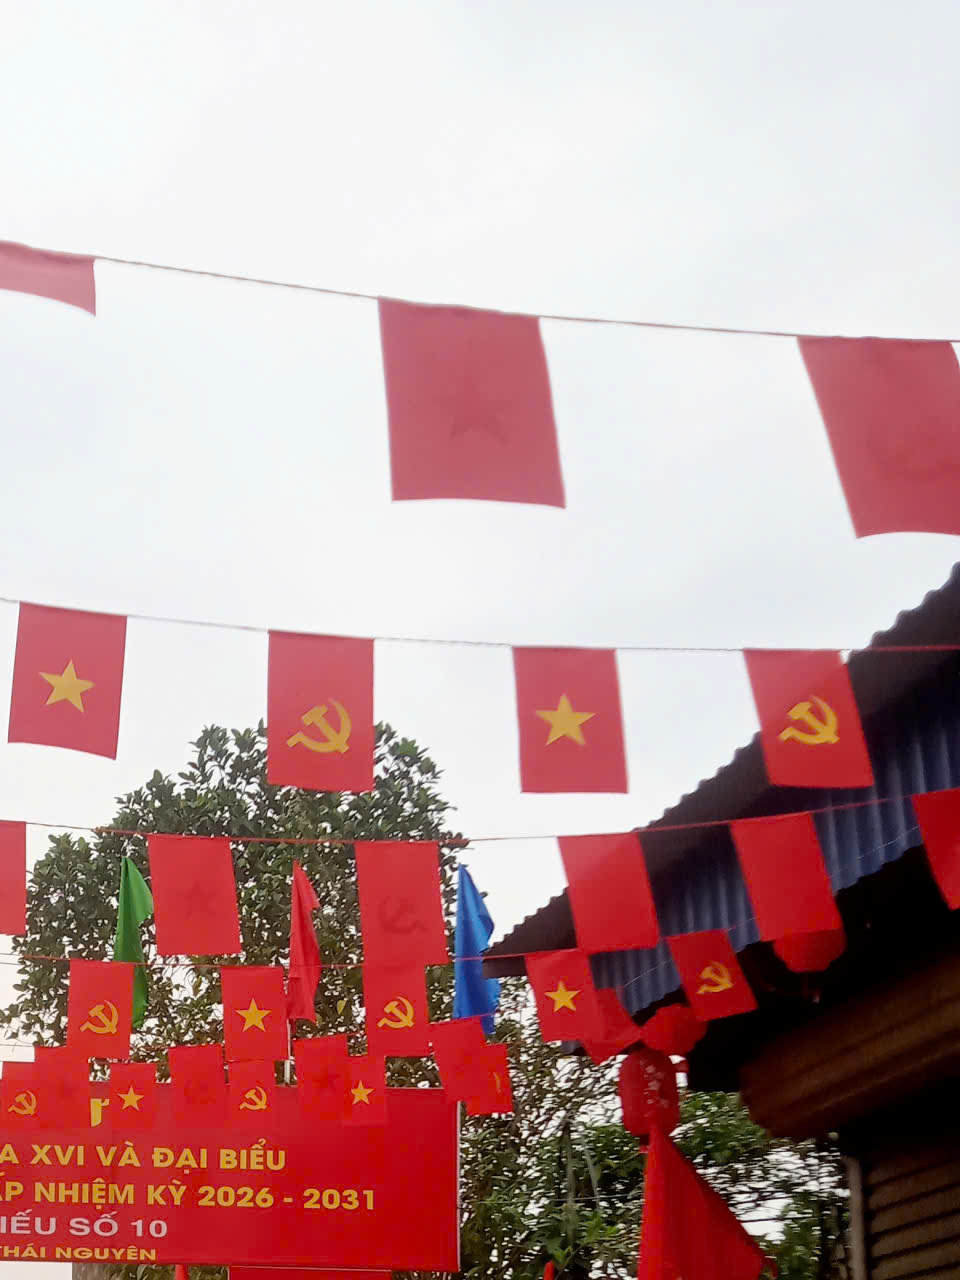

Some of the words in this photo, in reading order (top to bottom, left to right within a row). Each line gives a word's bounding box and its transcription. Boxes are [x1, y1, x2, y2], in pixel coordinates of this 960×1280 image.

[30, 1145, 84, 1165] XVI
[96, 1141, 141, 1167] VÀ
[151, 1147, 208, 1174] ĐẠI
[220, 1138, 285, 1170] BIỂU
[35, 1178, 134, 1207] NHIỆM
[147, 1180, 186, 1205] KỲ
[198, 1186, 273, 1207] 2026
[304, 1189, 373, 1209] 2031
[69, 1207, 118, 1236] SỐ
[131, 1220, 167, 1237] 10
[55, 1244, 157, 1261] NGUYÊN
